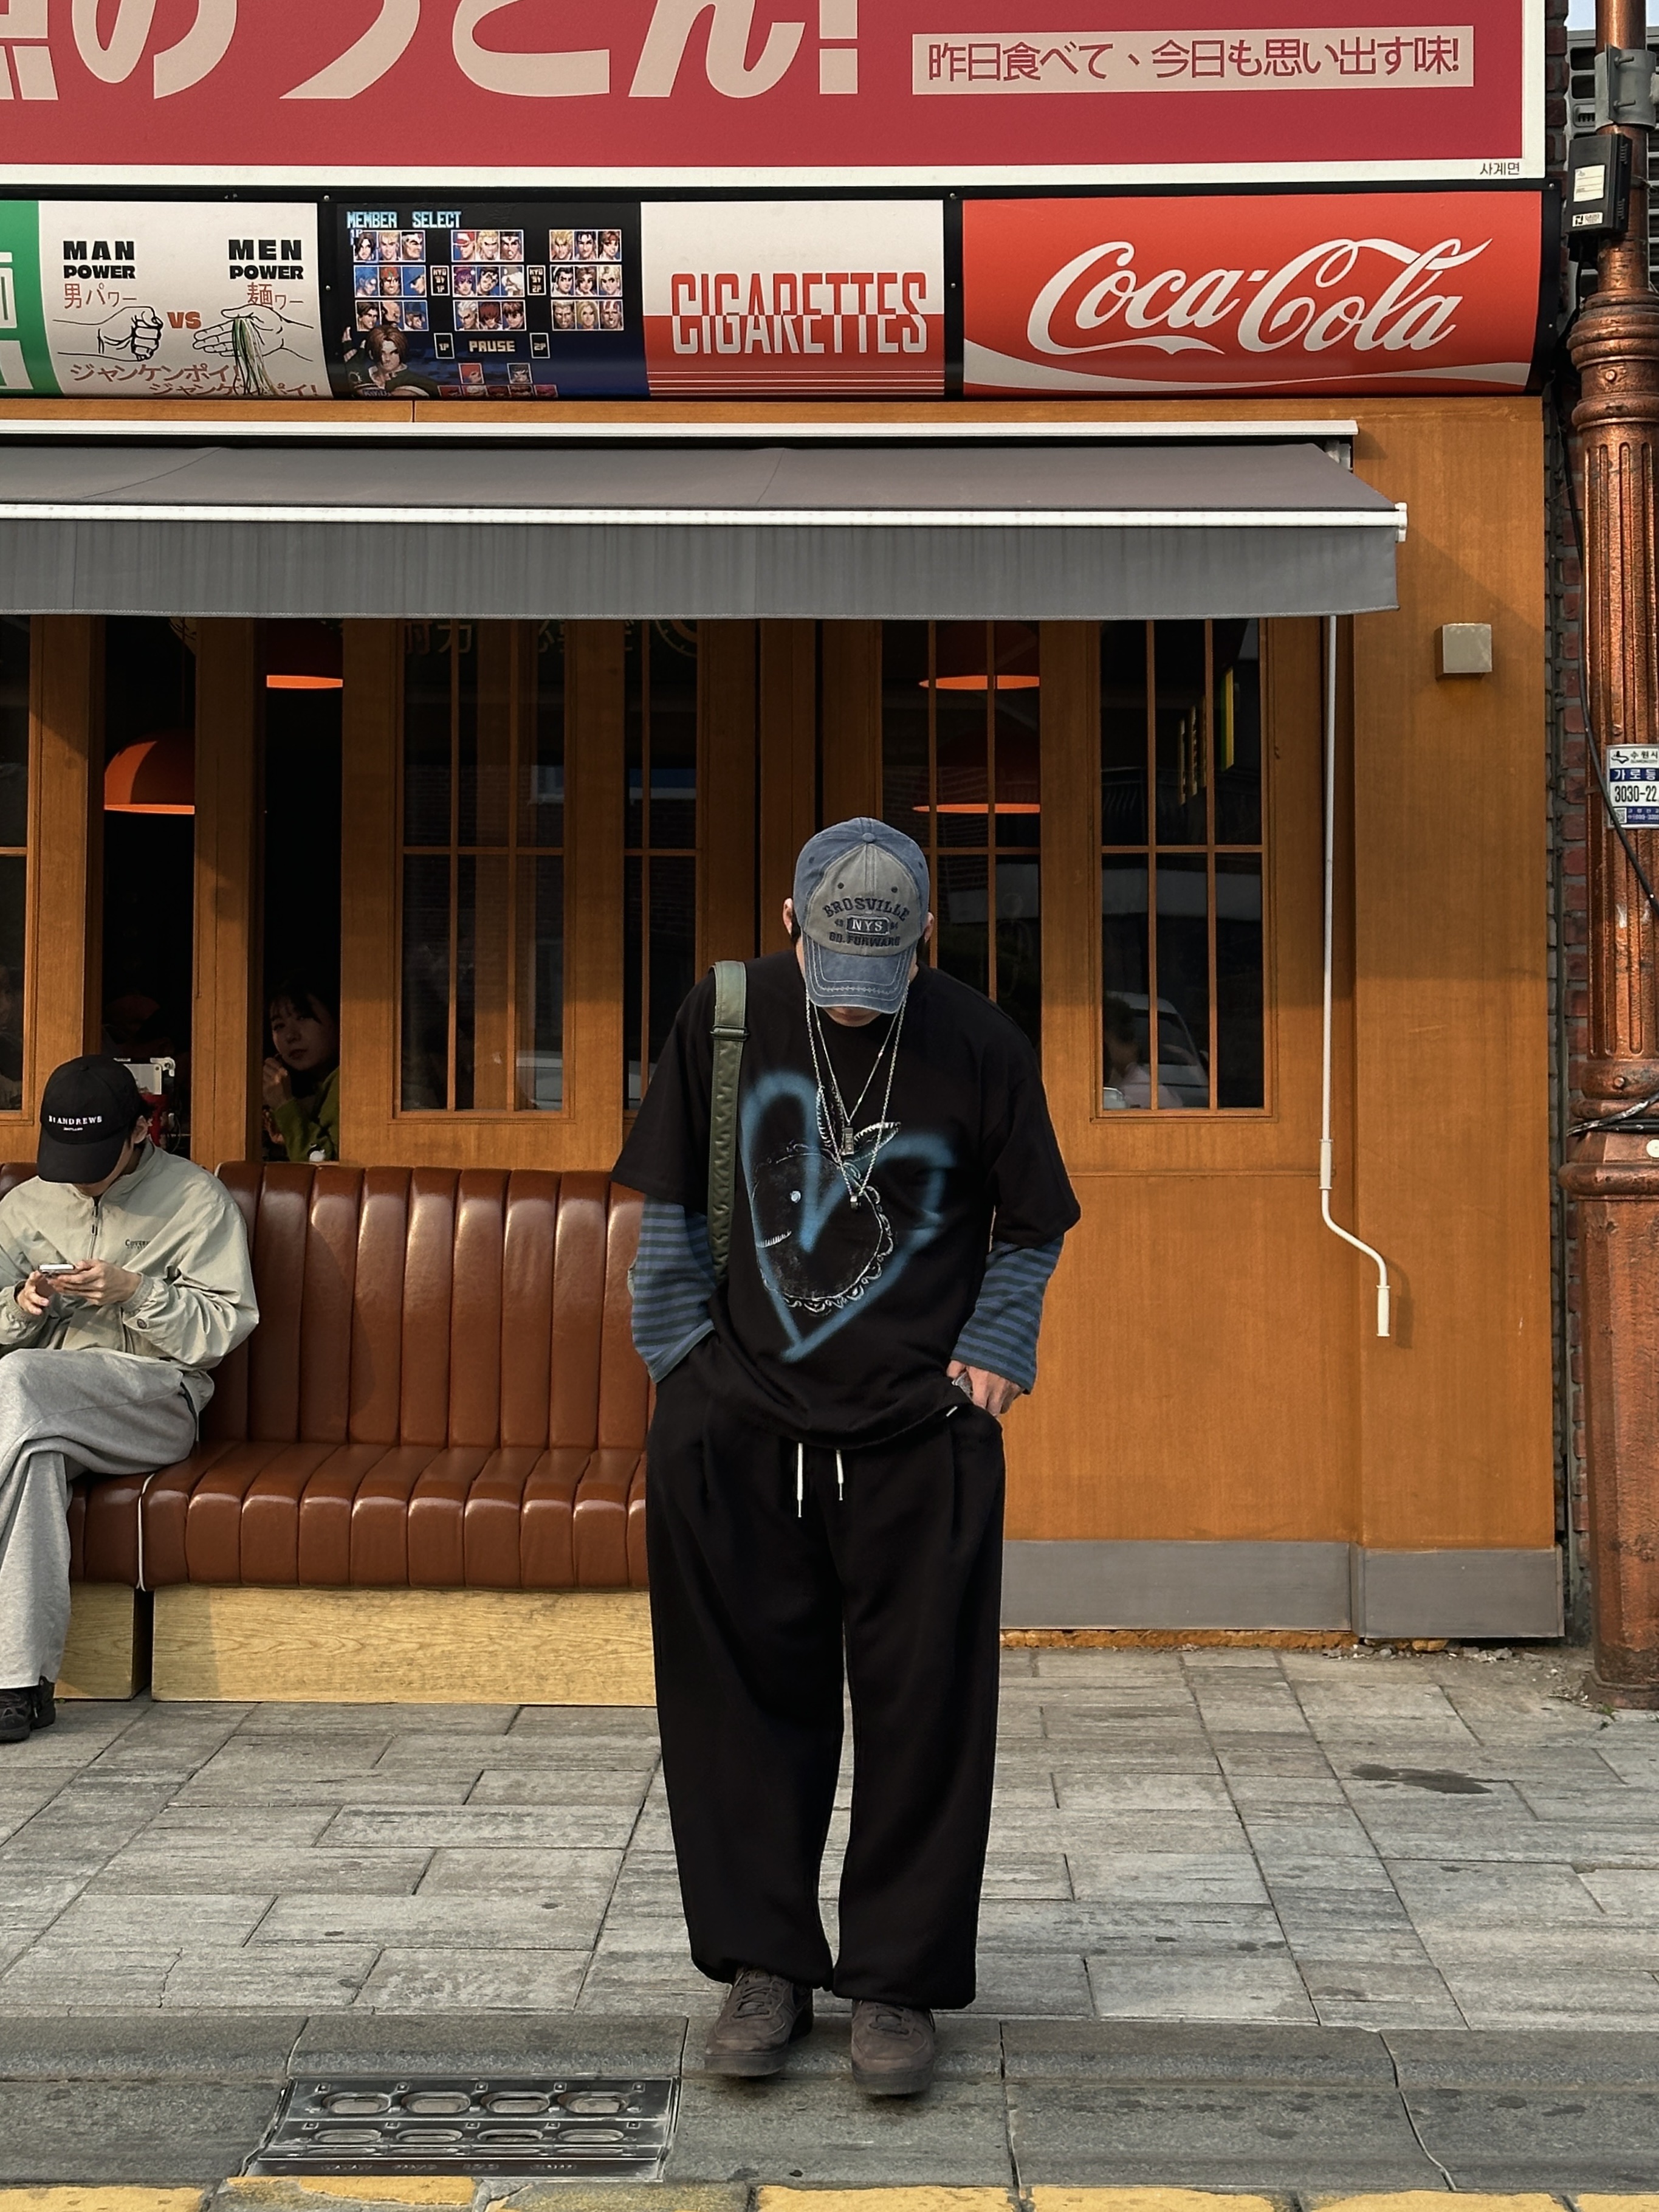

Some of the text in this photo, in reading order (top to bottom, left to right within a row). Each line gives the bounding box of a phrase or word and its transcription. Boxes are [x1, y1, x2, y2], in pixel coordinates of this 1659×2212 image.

[347, 211, 461, 228] MEMBER SELECT
[63, 240, 135, 261] MAN
[228, 239, 302, 261] MEN
[64, 265, 136, 280] POWER
[230, 265, 304, 280] POWER
[64, 283, 137, 309] 男パワー
[1027, 238, 1493, 355] Coca-Cola
[167, 311, 202, 329] VS
[671, 272, 927, 354] CIGARETTES
[469, 340, 516, 353] PAUSE
[1614, 768, 1656, 780] 가로등
[1615, 785, 1657, 802] 3030-22
[851, 919, 884, 932] NYS
[57, 1115, 103, 1126] ANDREWS
